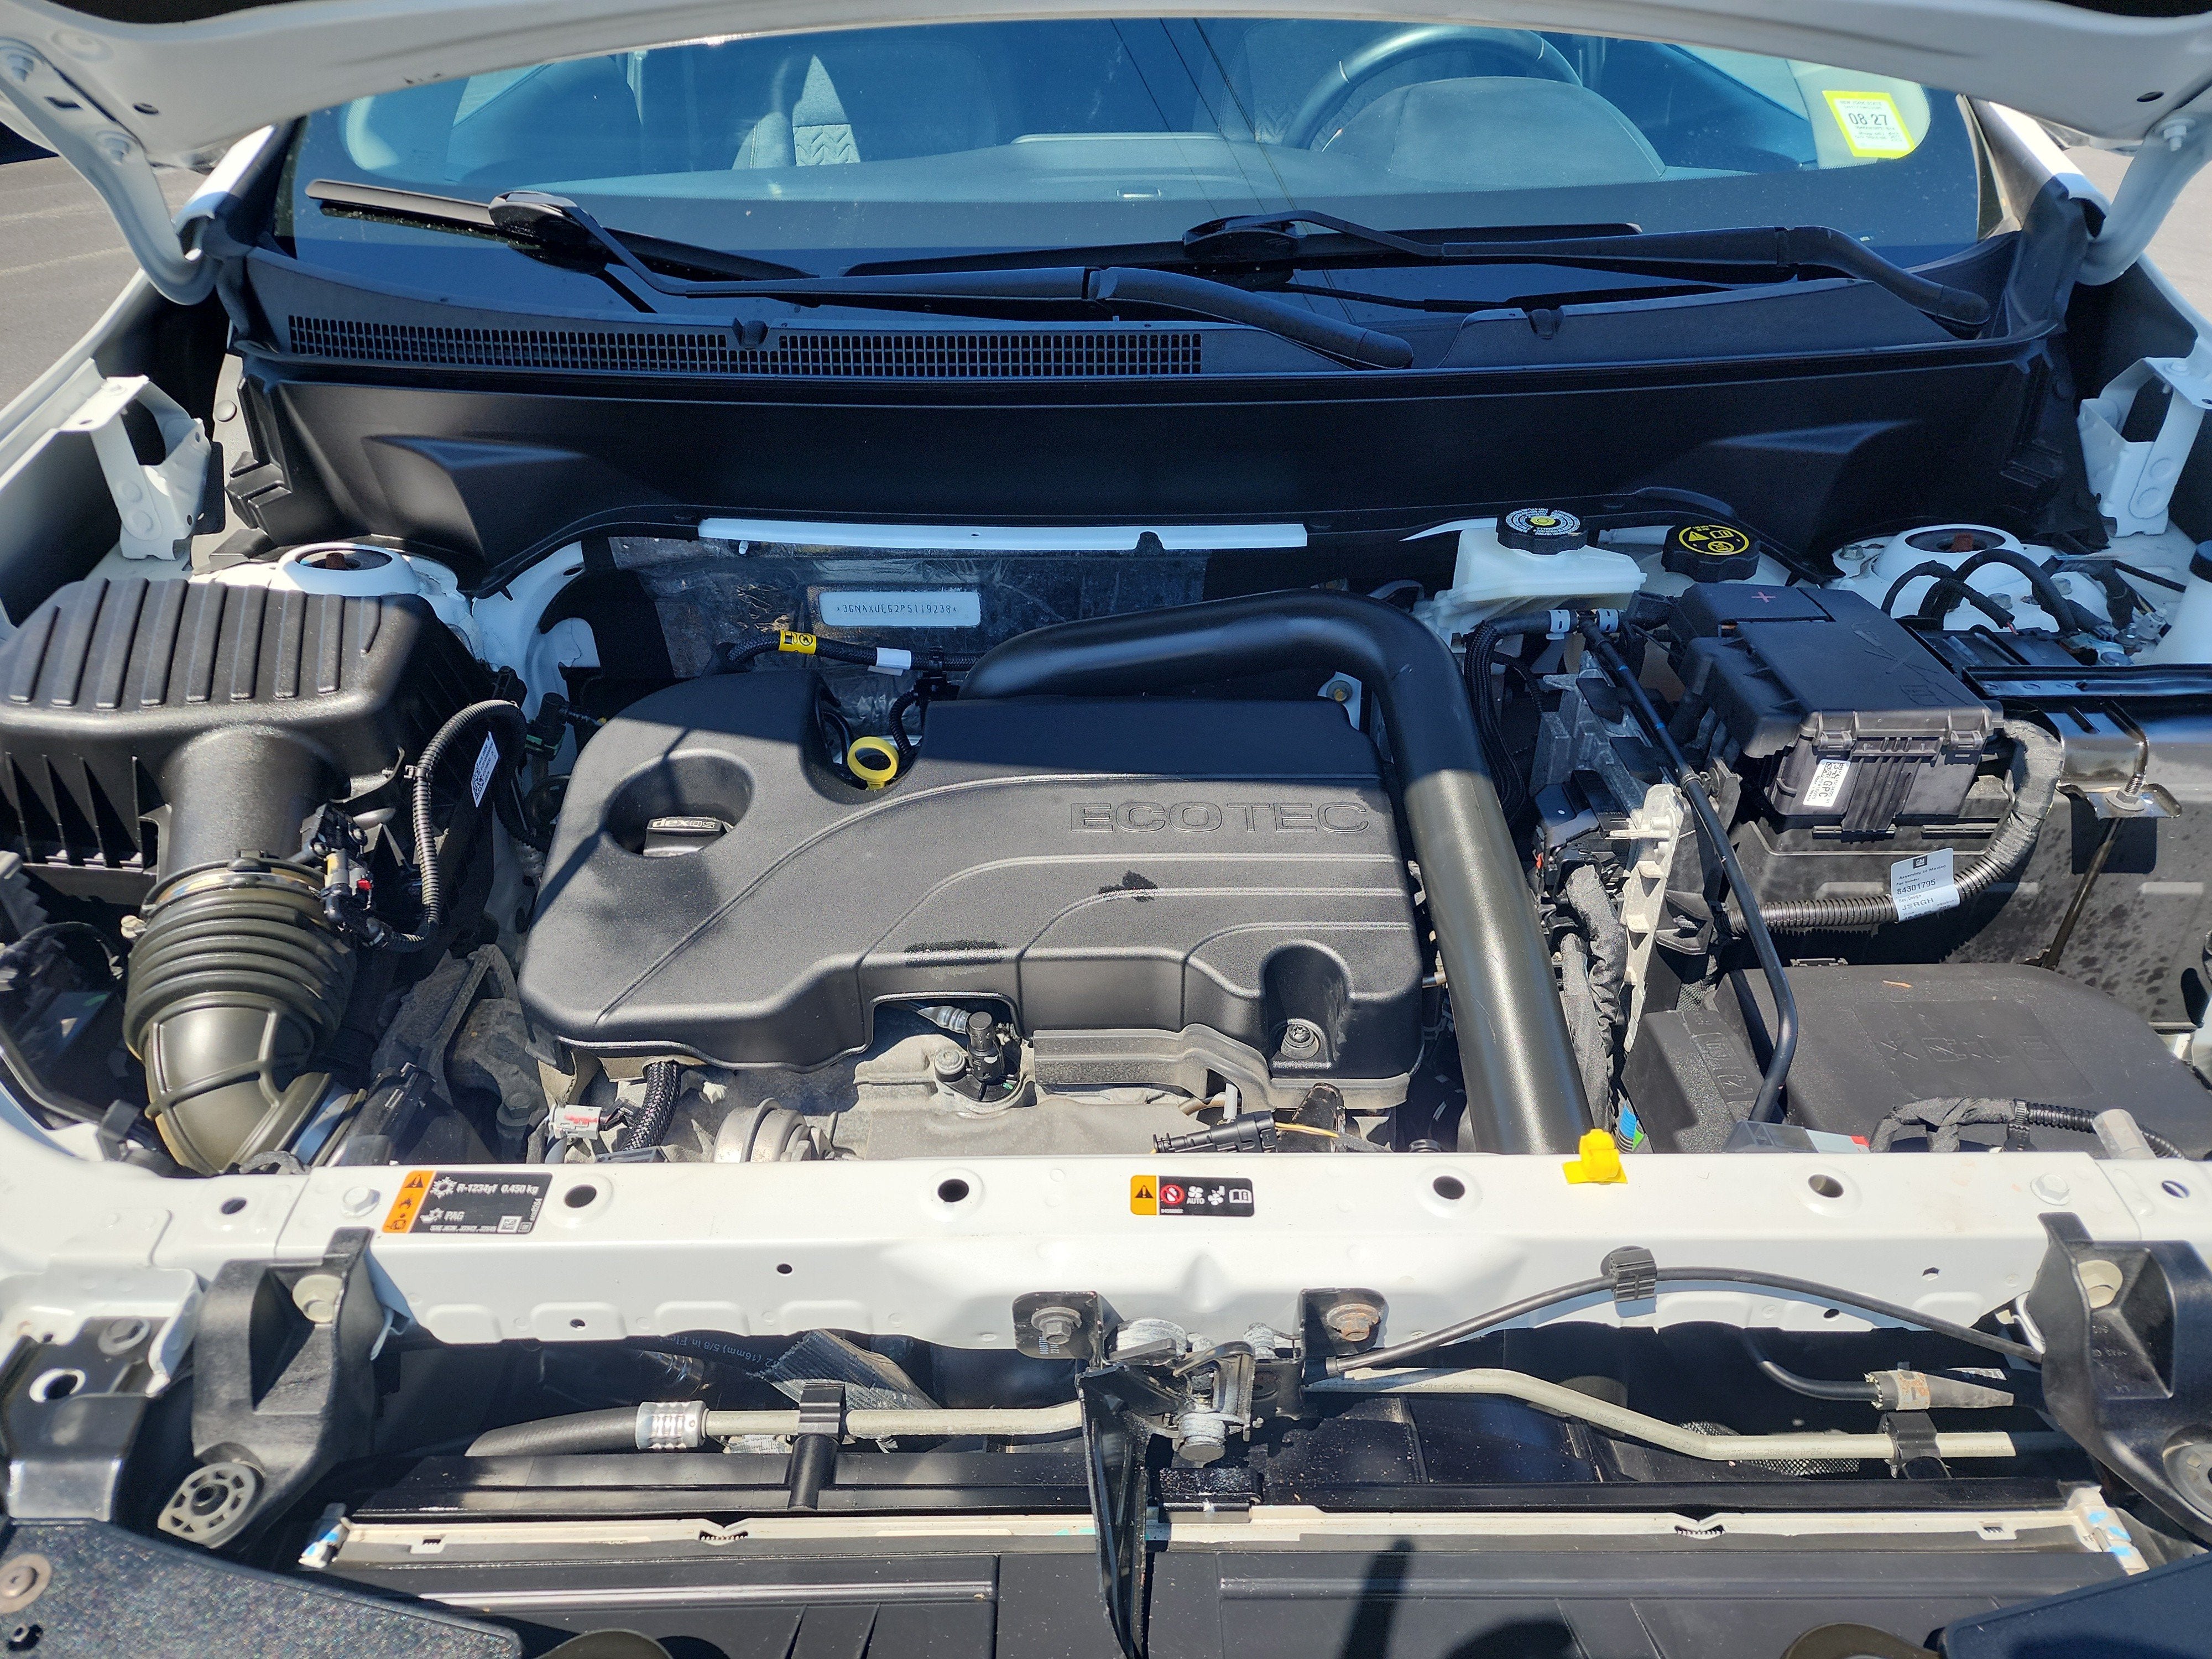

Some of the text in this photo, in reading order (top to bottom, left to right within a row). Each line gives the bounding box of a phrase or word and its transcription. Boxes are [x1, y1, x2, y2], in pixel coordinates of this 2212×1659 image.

[1848, 112, 1887, 126] 08 27
[1818, 780, 1833, 797] GPC
[652, 818, 716, 830] dexos
[1070, 802, 1369, 832] ECOTEC
[1898, 872, 1922, 880] Assembly
[1897, 879, 1936, 895] 84301795
[1902, 897, 1934, 911] JSRGH
[456, 1183, 540, 1196] R-1234yf 0.450 kg
[444, 1211, 466, 1223] PAG
[703, 1341, 720, 1352] 5/8
[723, 1344, 763, 1363] (16mm)
